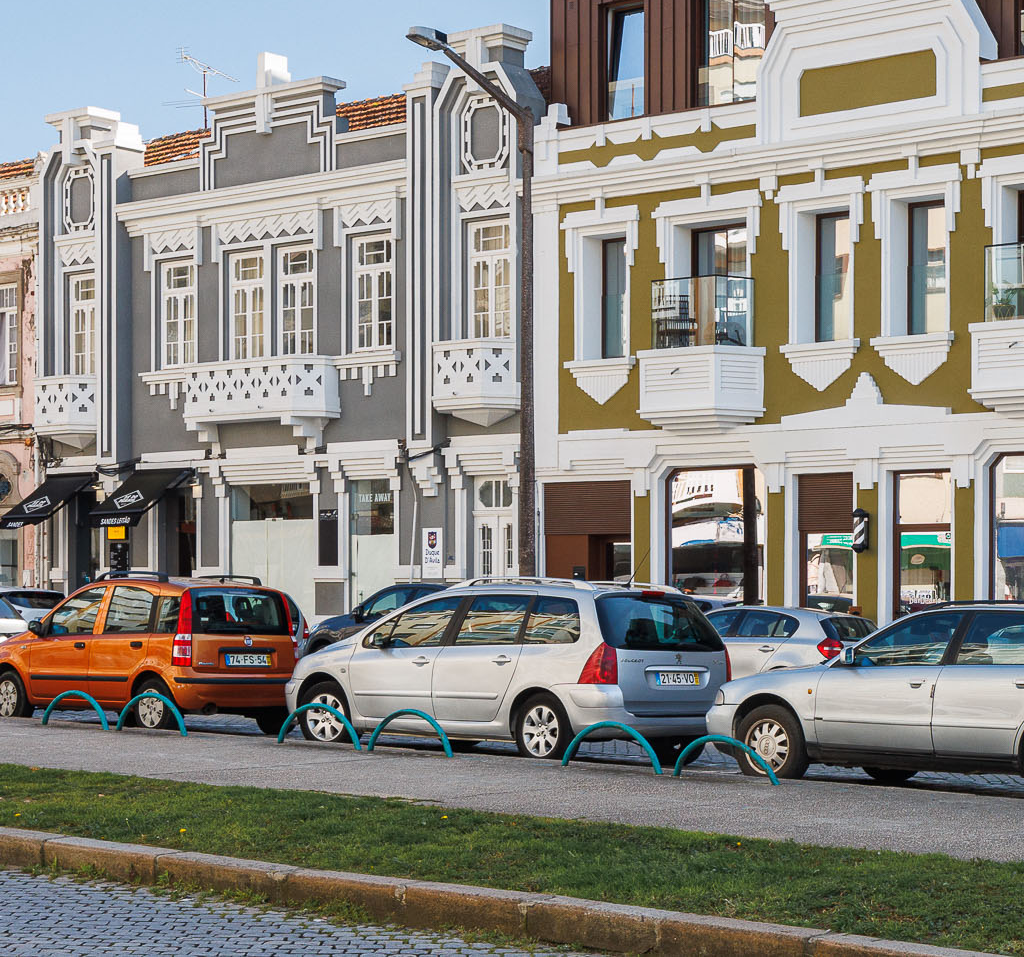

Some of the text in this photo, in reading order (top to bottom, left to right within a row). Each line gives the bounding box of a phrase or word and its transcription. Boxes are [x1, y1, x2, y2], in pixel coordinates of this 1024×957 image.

[359, 492, 391, 502] TAKE AWAY
[425, 548, 440, 557] Duque
[660, 673, 695, 684] 21-45-VO
